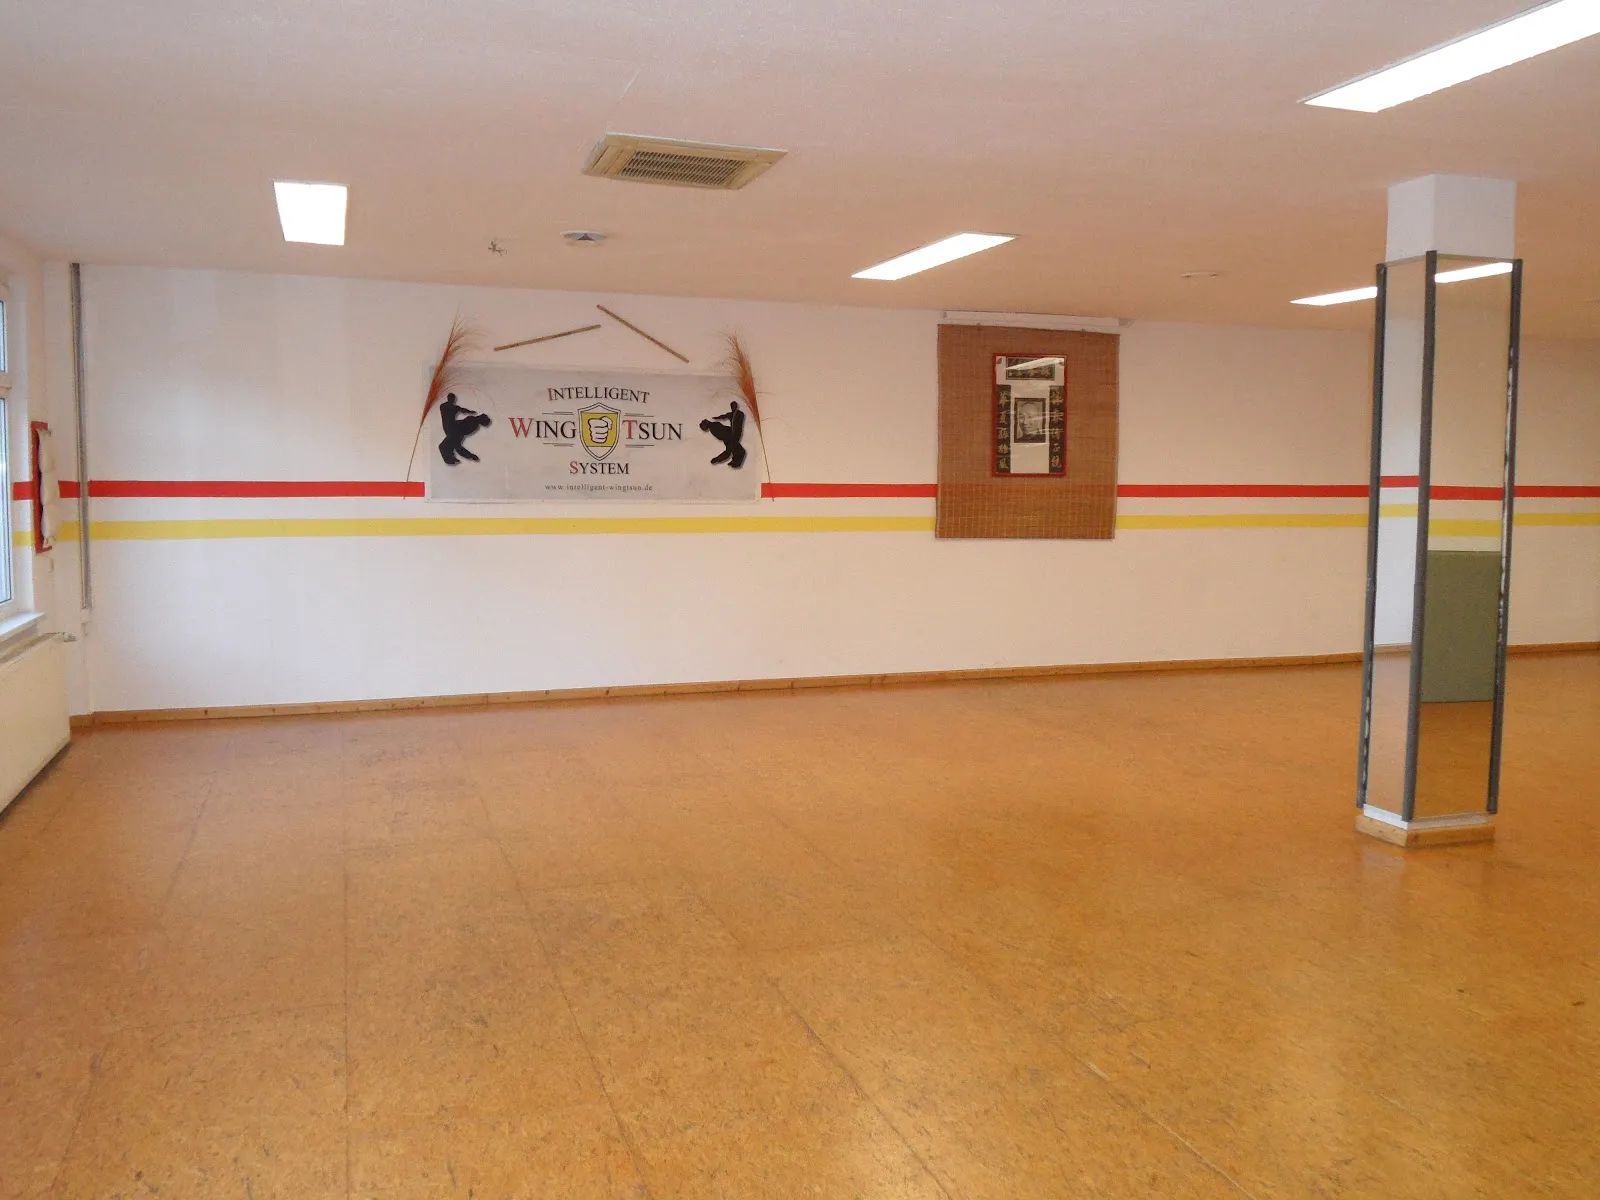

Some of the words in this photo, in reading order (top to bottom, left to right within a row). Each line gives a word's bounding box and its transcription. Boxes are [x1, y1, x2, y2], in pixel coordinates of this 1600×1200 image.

[547, 387, 650, 404] INTELLIGENT
[508, 417, 577, 440] WING
[622, 419, 683, 441] TSUN
[569, 461, 630, 475] SYSTEM
[544, 483, 653, 492] www.intelligent-wingtsun.de
